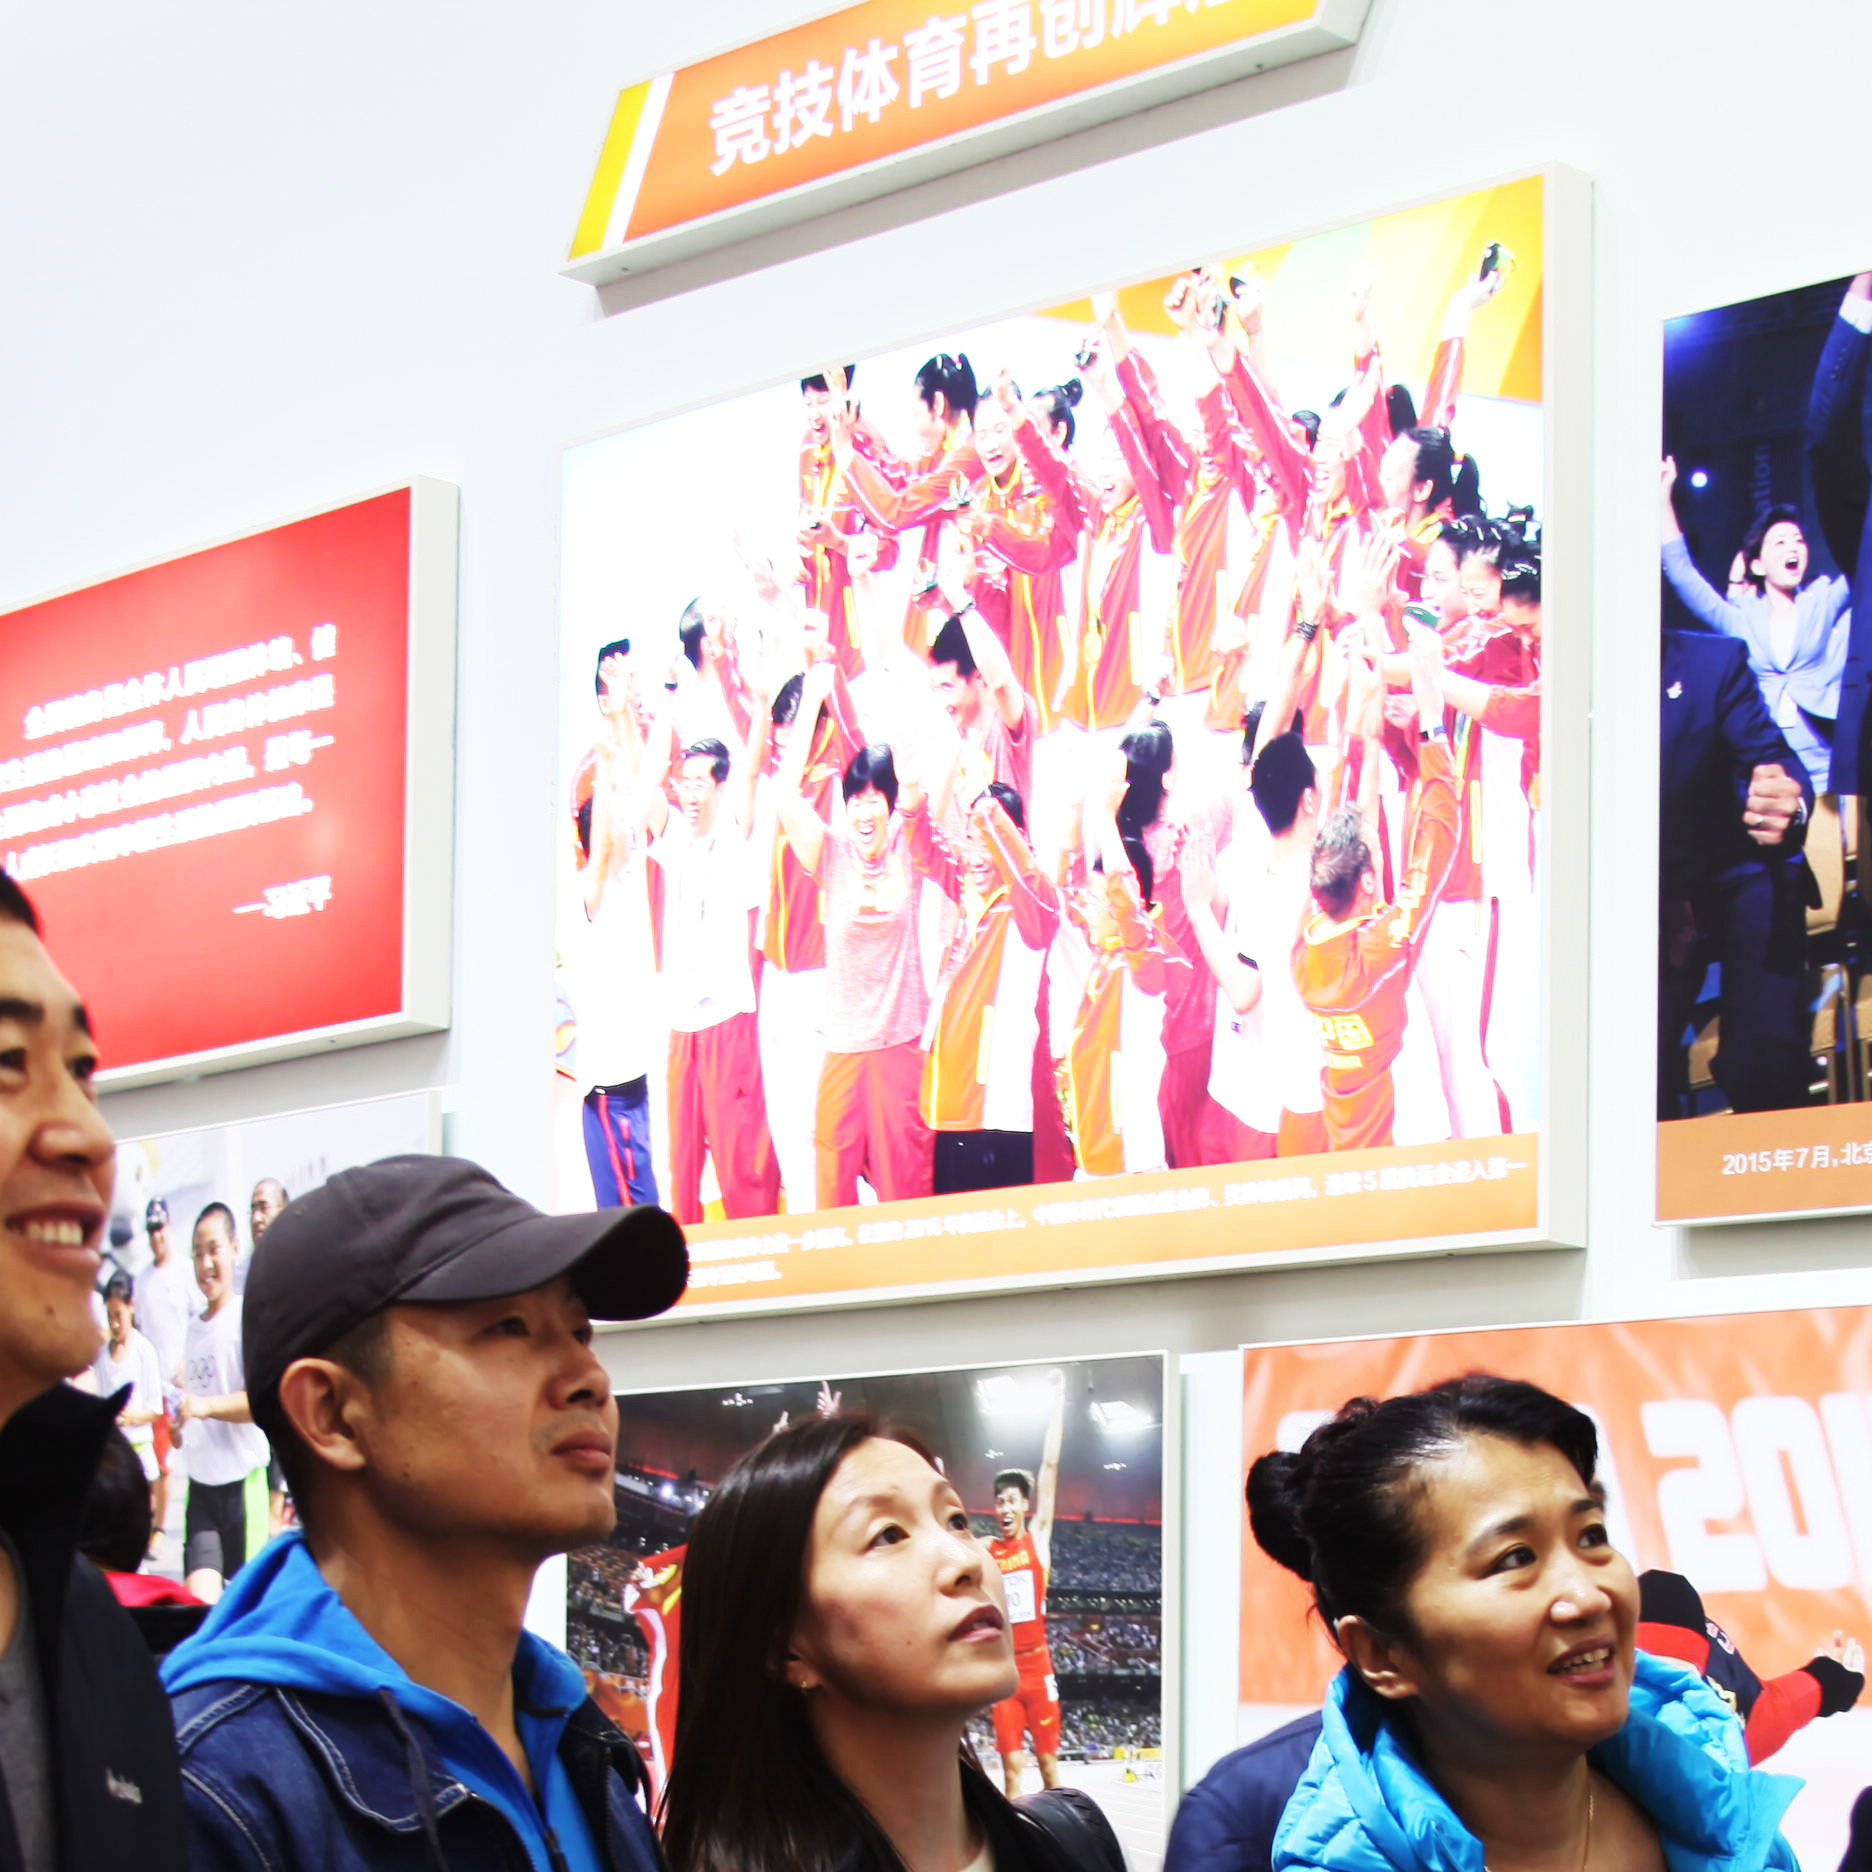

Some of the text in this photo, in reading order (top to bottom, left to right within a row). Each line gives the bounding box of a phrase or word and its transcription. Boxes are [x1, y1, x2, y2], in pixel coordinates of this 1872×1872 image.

[708, 0, 1228, 177] 竞技体育再创
